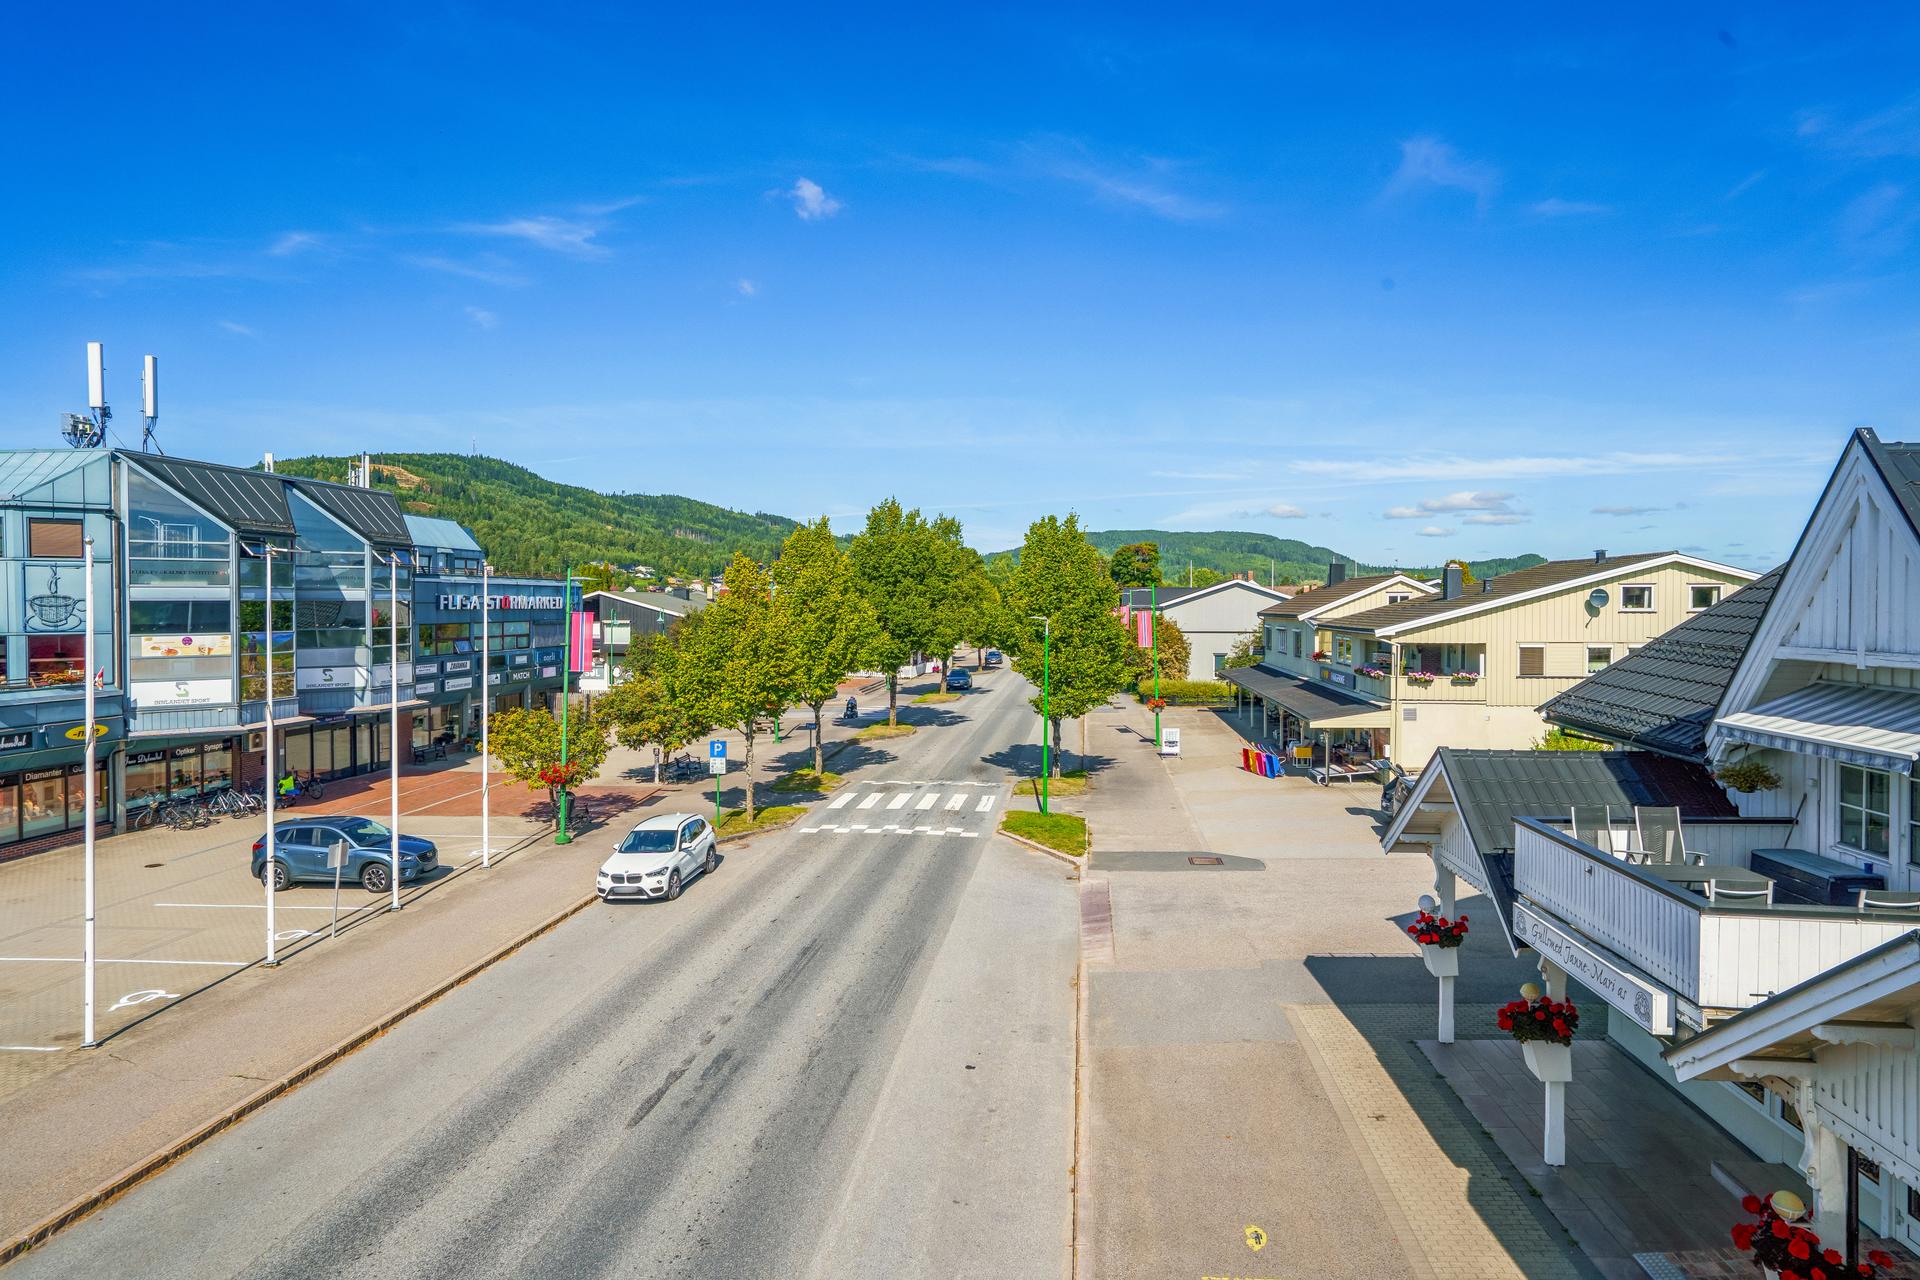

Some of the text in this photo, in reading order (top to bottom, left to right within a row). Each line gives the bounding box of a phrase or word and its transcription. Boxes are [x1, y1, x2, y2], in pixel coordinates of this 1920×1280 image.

[440, 594, 480, 610] FLISA
[513, 671, 530, 681] MATCH
[175, 746, 197, 757] Optiker
[714, 743, 723, 756] P
[25, 769, 63, 781] Diamanter
[1531, 923, 1562, 957] Gullsmed
